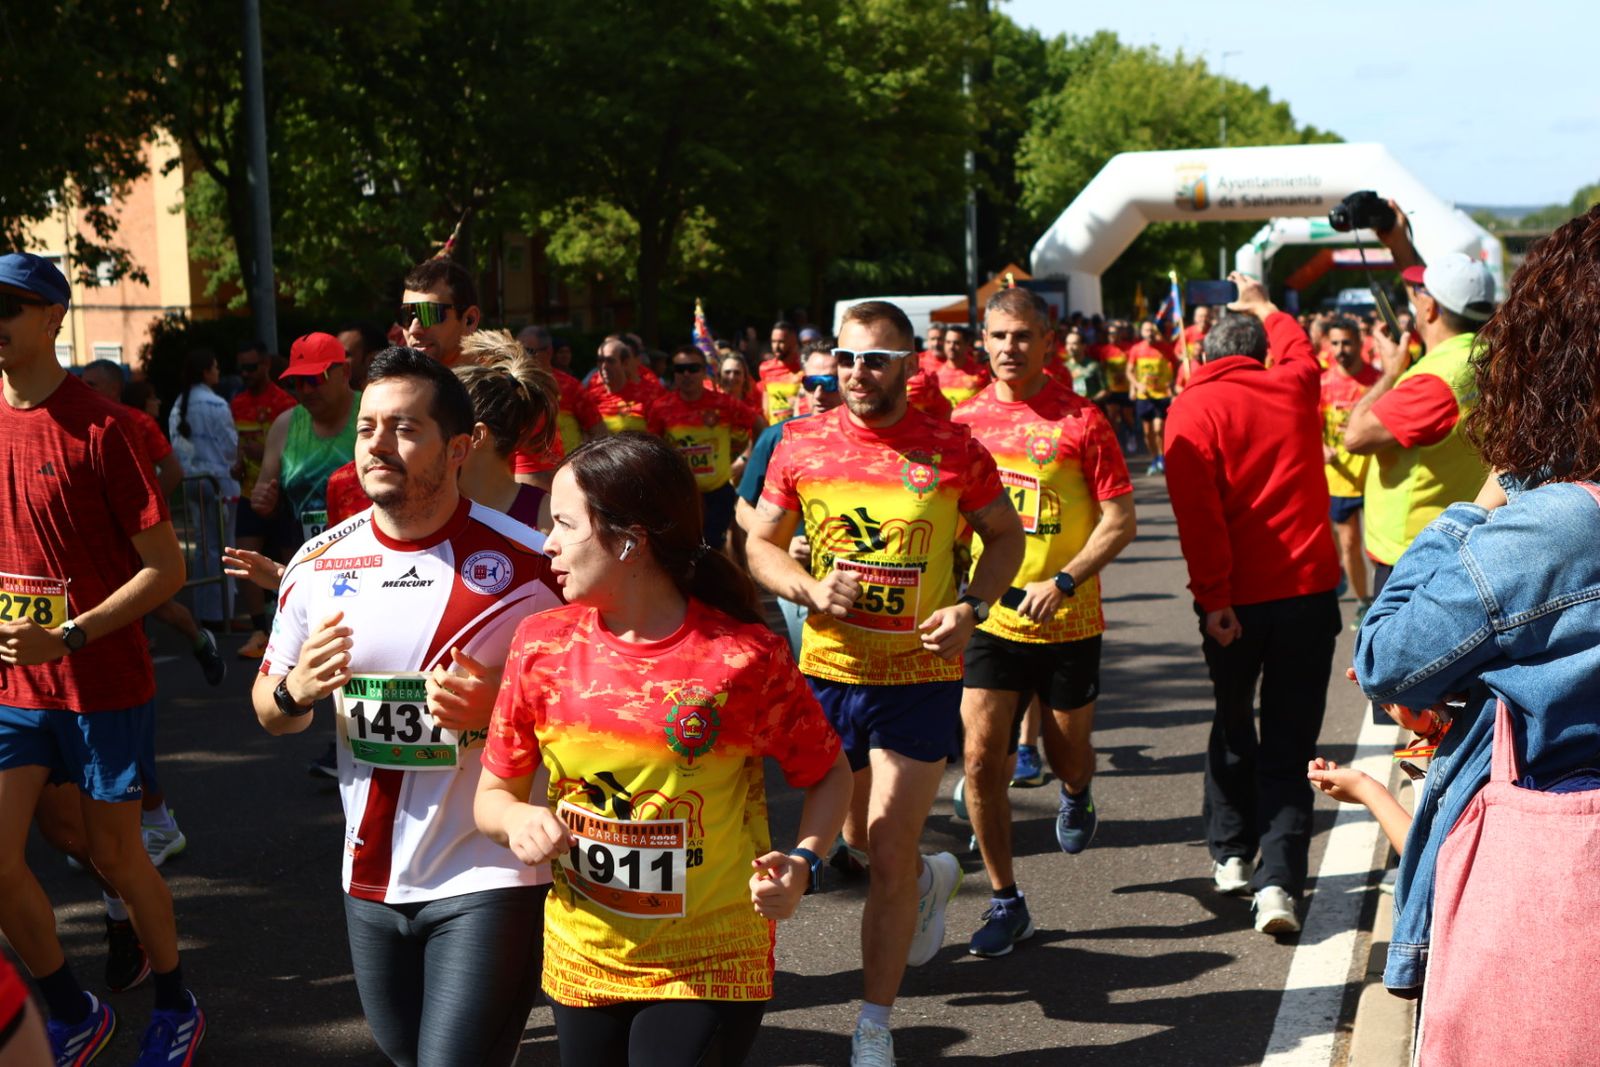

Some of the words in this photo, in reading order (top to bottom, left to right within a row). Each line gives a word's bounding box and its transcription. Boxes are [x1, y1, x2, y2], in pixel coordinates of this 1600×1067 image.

[1217, 175, 1322, 191] Ayuntamiento
[1218, 196, 1235, 208] de
[1241, 193, 1323, 208] Salamanca
[306, 540, 325, 553] LA
[328, 517, 367, 542] RIOJA
[315, 555, 383, 571] BAUHAUS
[5, 583, 41, 593] CARRERA
[381, 579, 434, 588] MERCURY
[0, 594, 53, 625] 278
[345, 680, 368, 696] XIV
[369, 689, 422, 699] CARRERA
[561, 809, 586, 833] XIV
[588, 819, 609, 831] SAN
[619, 825, 680, 835] FERNANDO
[587, 827, 647, 845] CARRERA
[570, 839, 674, 892] 1911
[711, 984, 729, 999] POR
